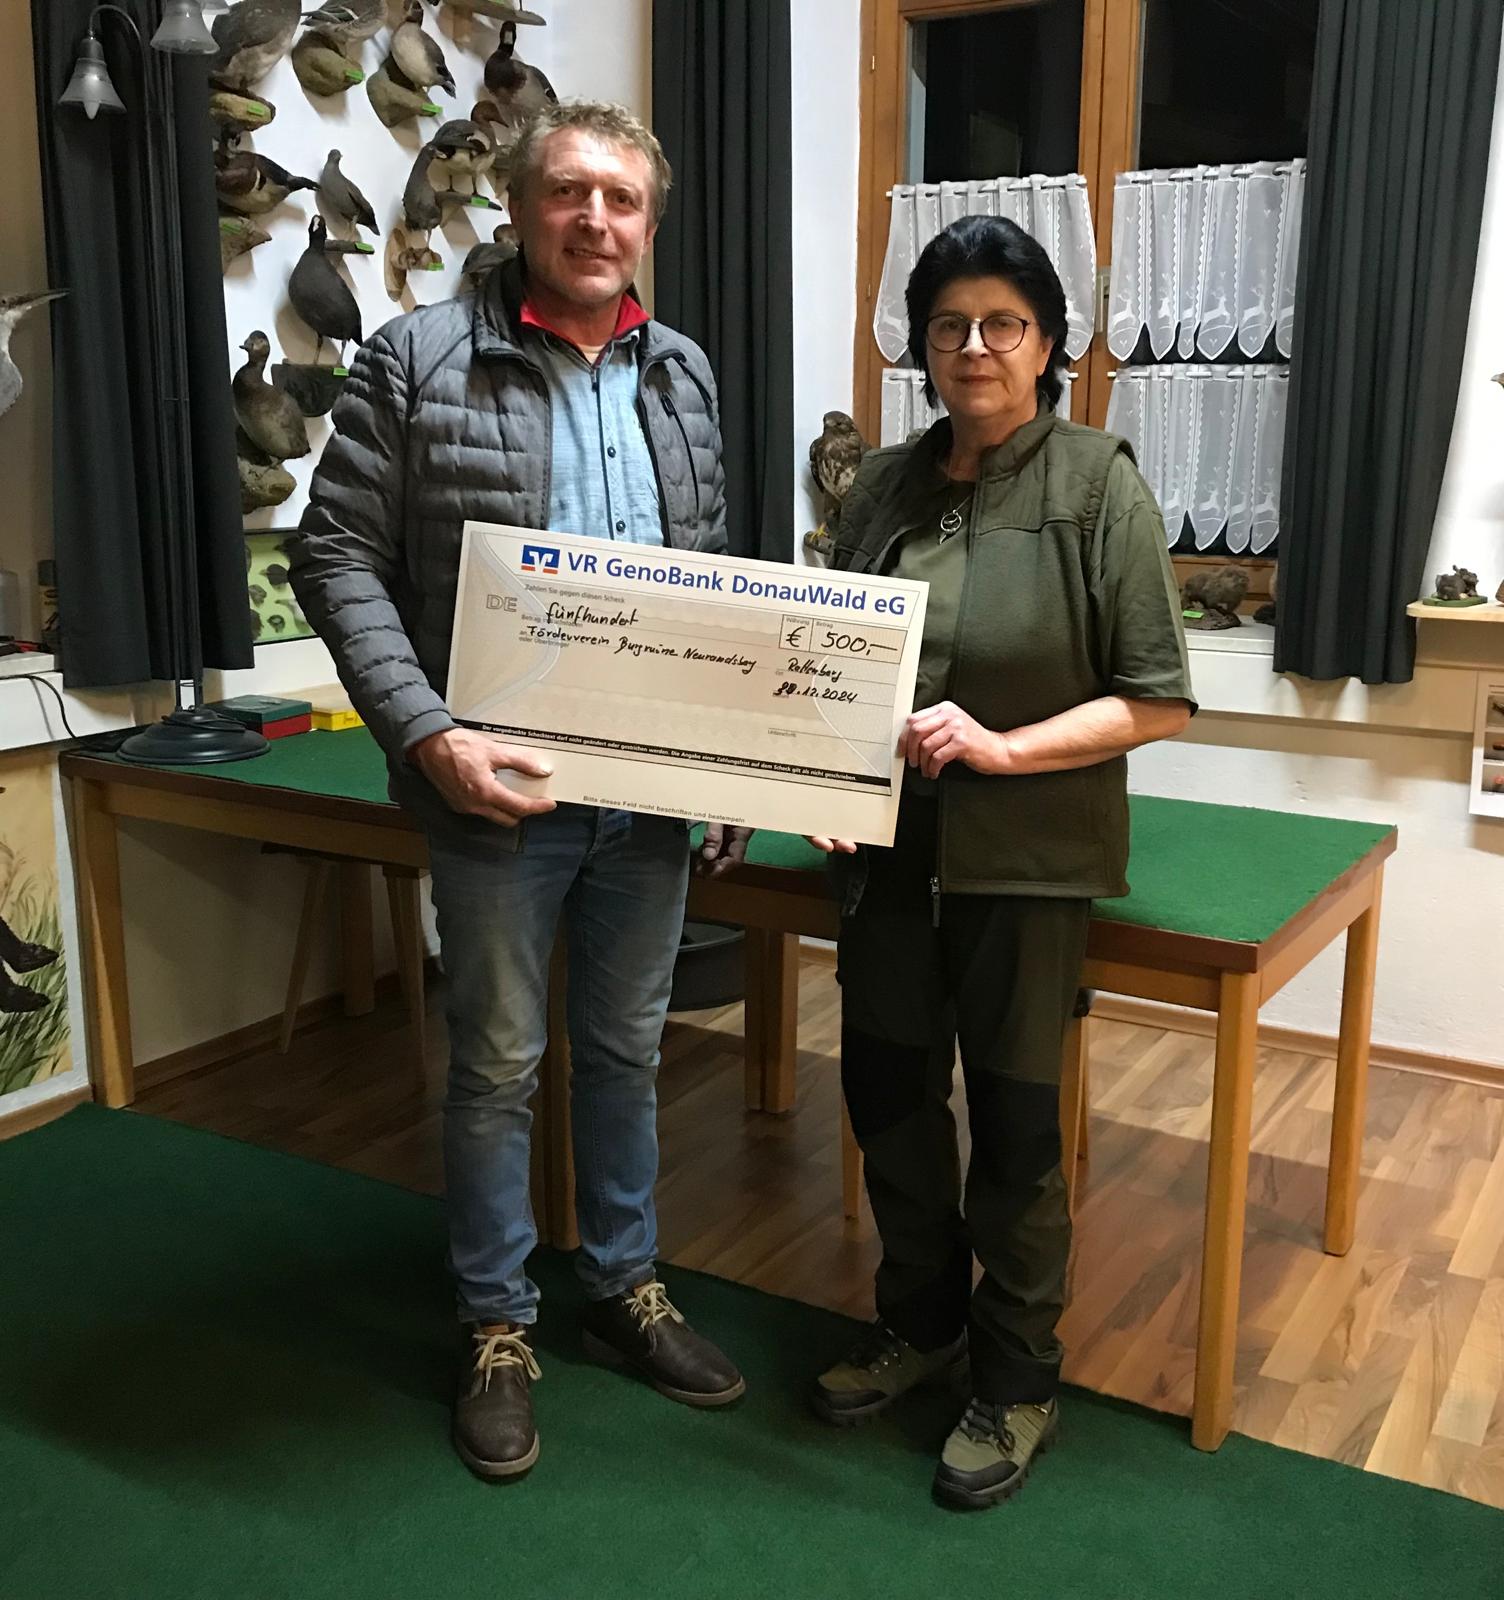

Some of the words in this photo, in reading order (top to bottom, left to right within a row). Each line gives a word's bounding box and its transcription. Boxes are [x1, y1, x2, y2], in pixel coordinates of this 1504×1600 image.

[525, 583, 547, 593] Zahlen
[559, 590, 580, 598] gegen
[581, 591, 603, 600] diesen
[603, 595, 625, 604] Scheck
[567, 552, 598, 574] VR
[606, 558, 723, 591] GenoBank
[732, 575, 867, 611] DonauWald
[874, 596, 905, 616] eG
[486, 594, 518, 612] DE
[786, 626, 805, 647] €
[774, 764, 791, 772] Scheck
[622, 800, 637, 808] Feld
[639, 802, 655, 811] nicht
[656, 805, 692, 817] beschriften
[694, 810, 706, 818] und
[708, 812, 745, 824] bestempeln
